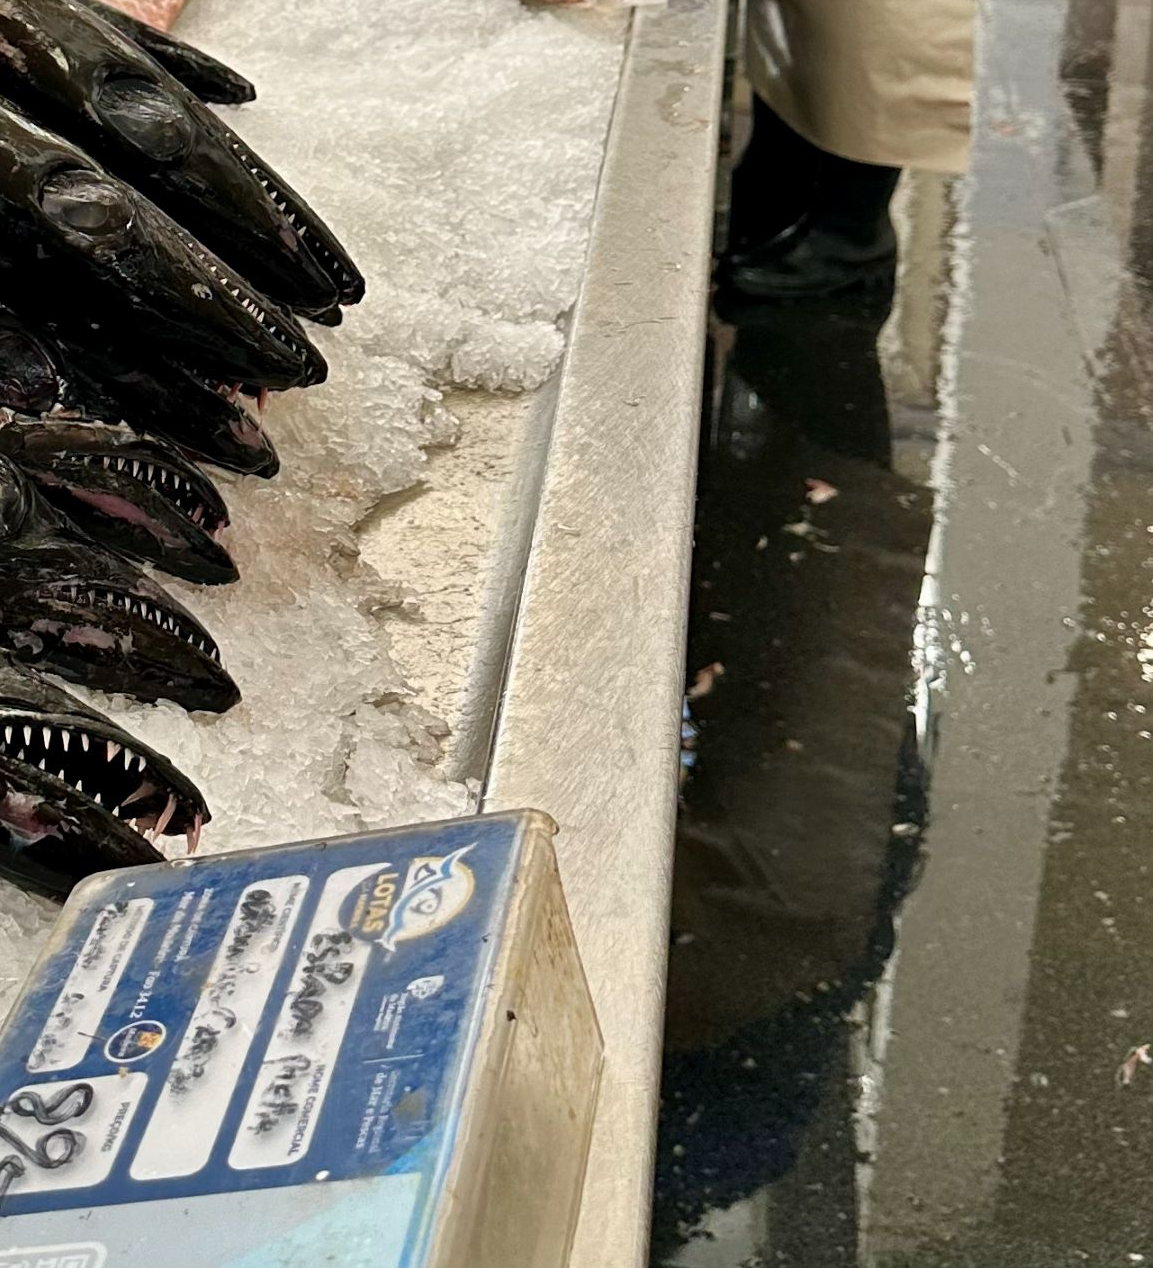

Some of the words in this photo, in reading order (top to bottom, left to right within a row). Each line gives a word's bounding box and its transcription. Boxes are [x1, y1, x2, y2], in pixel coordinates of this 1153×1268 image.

[363, 871, 400, 933] LOTAS
[96, 953, 123, 991] CAPTURA
[307, 1064, 326, 1093] NOME
[366, 1085, 383, 1105] Mar
[373, 1072, 386, 1084] de
[100, 1101, 131, 1152] PREÇO/KG
[285, 1095, 317, 1155] COMERCIAL
[353, 1115, 374, 1148] Pescas
[366, 1114, 389, 1153] Regional
